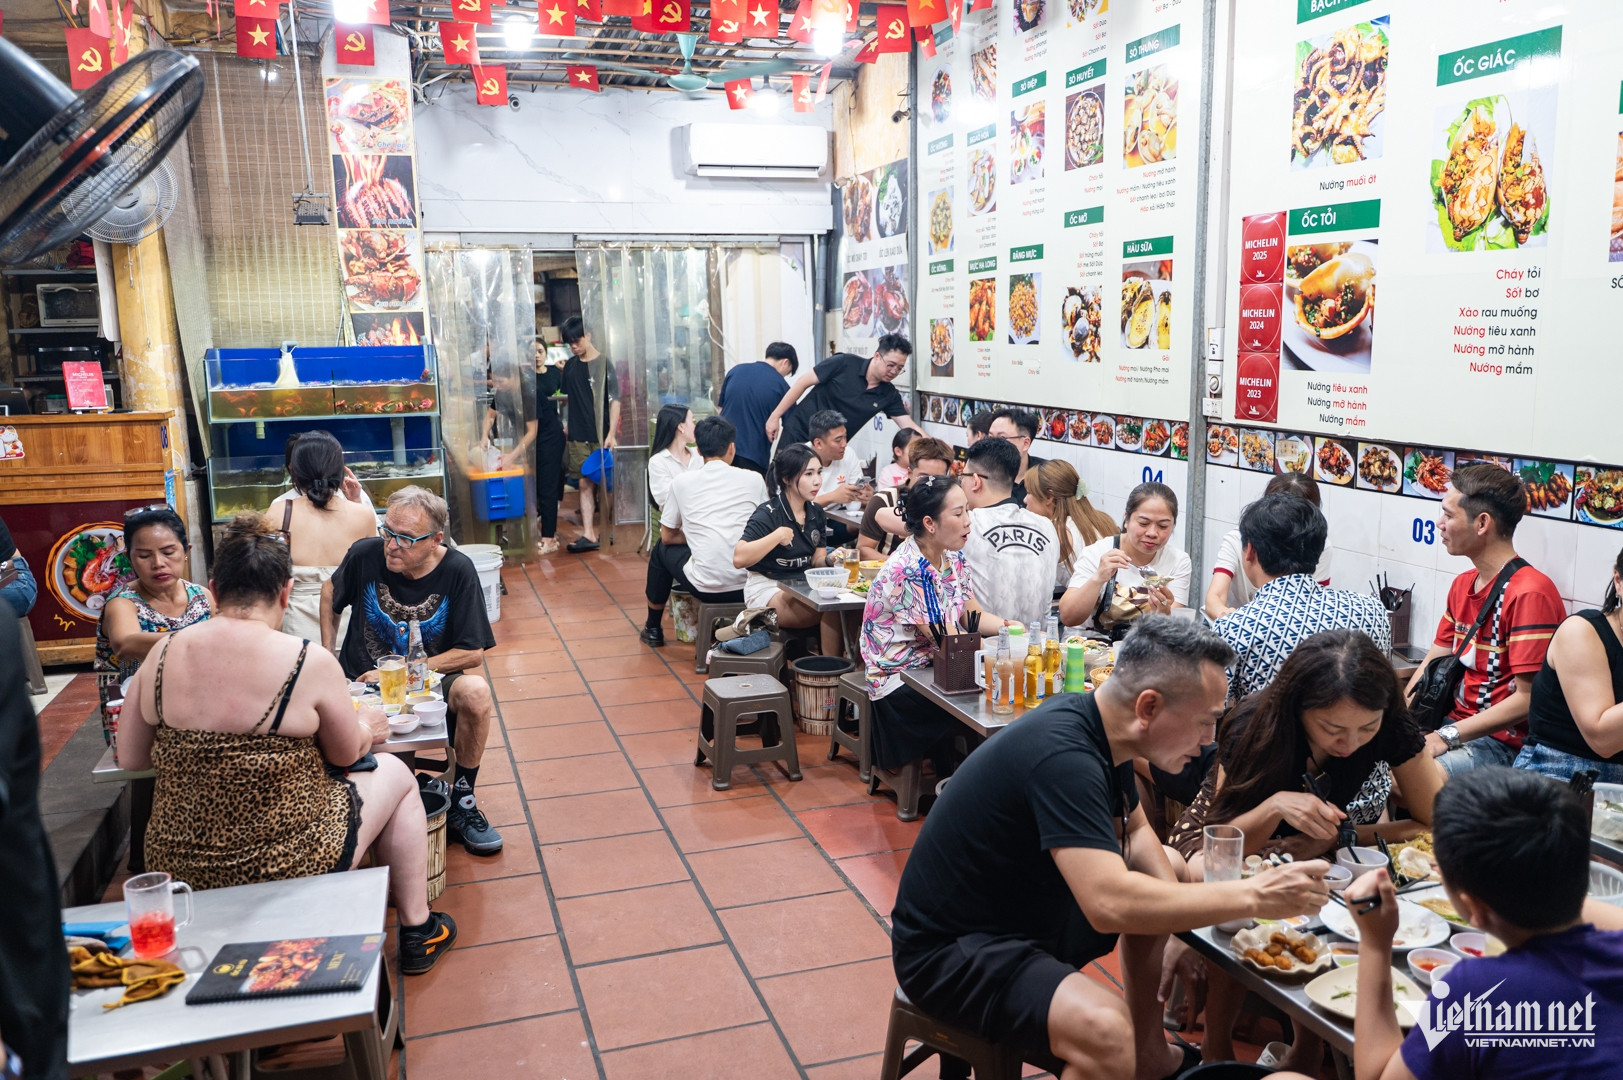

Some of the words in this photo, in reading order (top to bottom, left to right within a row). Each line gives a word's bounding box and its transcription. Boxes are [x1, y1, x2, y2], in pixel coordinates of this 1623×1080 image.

[1453, 56, 1474, 76] ỐC
[1478, 48, 1516, 71] GIÁC
[1069, 73, 1076, 85] SÒ
[1077, 66, 1094, 82] HUYẾT
[1320, 179, 1344, 191] Nướng
[1346, 174, 1366, 187] muối
[1368, 174, 1377, 183] ớt
[1070, 213, 1077, 224] ỐC
[1302, 209, 1318, 227] ỐC
[1321, 208, 1337, 226] TỎI
[1127, 242, 1139, 253] HÀU
[1141, 241, 1153, 252] SỮA
[1245, 237, 1278, 249] MICHELIN
[1252, 251, 1267, 261] 2025
[1496, 269, 1524, 281] Cháy
[1528, 266, 1541, 278] tỏi
[1506, 286, 1522, 298] Sốt
[1525, 288, 1540, 298] bơ
[1242, 309, 1275, 318] MICHELIN
[1459, 307, 1478, 317] Xào
[1482, 309, 1497, 317] rau
[1501, 305, 1537, 320] muống
[1249, 320, 1264, 329] 2024
[1454, 325, 1485, 338] Nướng
[1488, 326, 1507, 336] tiêu
[1510, 327, 1536, 336] xanh
[1454, 343, 1485, 356] Nướng
[1488, 345, 1505, 354] mỡ
[1508, 345, 1534, 355] hành
[1470, 362, 1502, 375] Nướng
[1505, 361, 1533, 374] mắm
[1240, 378, 1272, 387] MICHELIN
[1308, 382, 1330, 393] Nướng
[1332, 383, 1346, 393] tiêu
[1349, 385, 1368, 395] xanh
[1247, 389, 1261, 398] 2023
[1308, 397, 1330, 409] Nướng
[1333, 398, 1345, 408] mỡ
[1347, 400, 1367, 410] hành
[874, 416, 883, 431] 06
[1320, 413, 1343, 426] Nướng
[1346, 415, 1366, 426] mắm
[1413, 518, 1435, 545] 03
[987, 529, 1047, 552] PARIS
